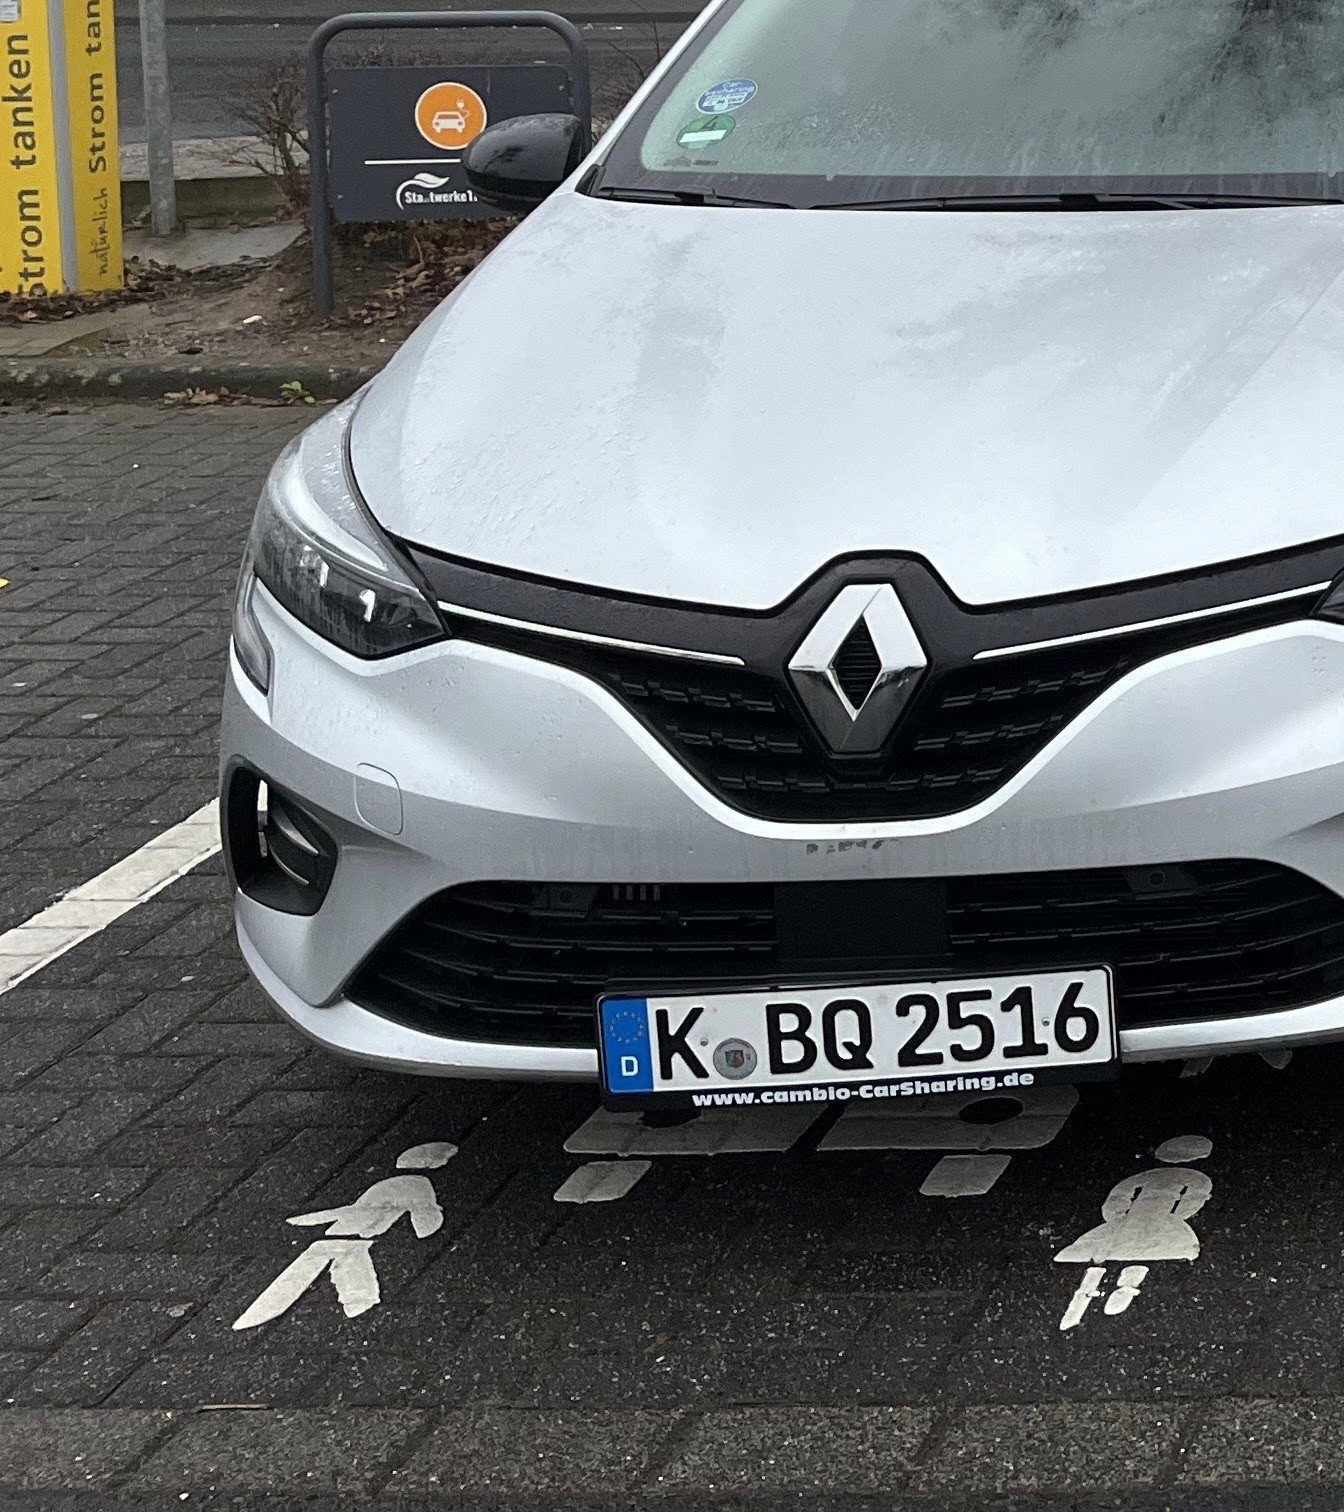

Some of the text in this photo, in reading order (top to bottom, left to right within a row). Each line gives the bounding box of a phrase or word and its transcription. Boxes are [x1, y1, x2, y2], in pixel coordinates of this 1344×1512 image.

[1, 33, 37, 170] tanken
[88, 72, 107, 173] Strom
[621, 1056, 639, 1078] D
[654, 981, 1100, 1081] K BQ 2516
[691, 1070, 1035, 1108] www.cambio-CarSharing.de
